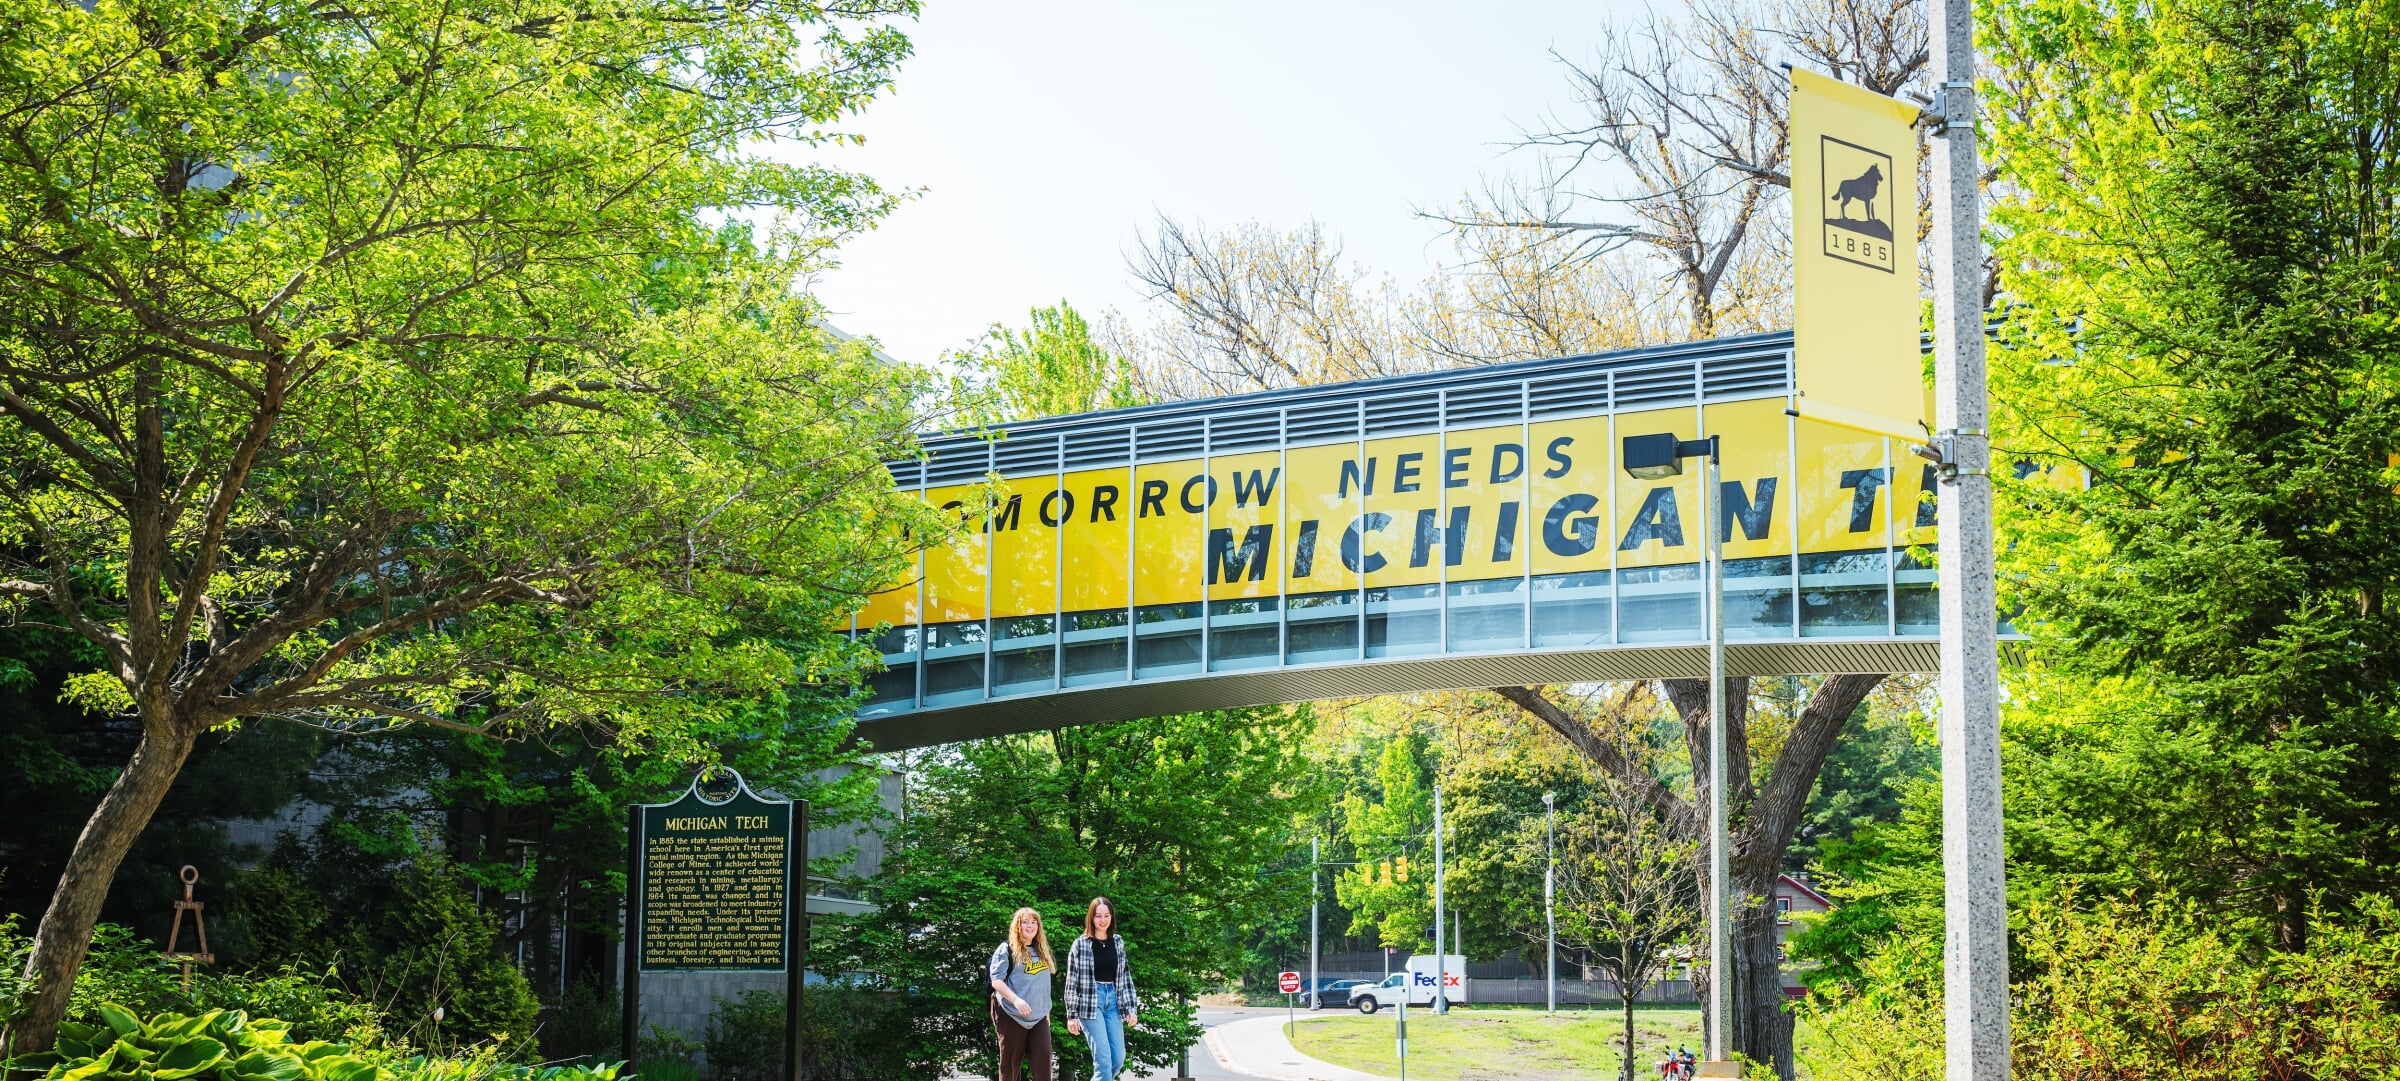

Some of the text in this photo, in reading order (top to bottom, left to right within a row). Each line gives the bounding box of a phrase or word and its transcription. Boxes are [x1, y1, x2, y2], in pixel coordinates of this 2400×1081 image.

[1832, 234, 1886, 261] 1885
[902, 436, 1574, 541] MORROW NEEDS
[1201, 476, 1778, 586] MICHIGAN
[666, 816, 769, 830] MICHIGAN TECH
[759, 836, 783, 844] mining
[764, 844, 783, 852] great
[671, 853, 694, 862] mining
[696, 852, 721, 861] region.
[751, 852, 783, 860] Michigan
[649, 861, 674, 870] College
[666, 885, 696, 893] geology.
[752, 884, 771, 892] again
[722, 892, 750, 901] changed
[748, 900, 782, 908] industry's
[648, 908, 683, 917] expanding
[755, 908, 781, 916] present
[672, 916, 702, 925] Michigan
[707, 916, 751, 925] Technological
[648, 932, 697, 941] undergraduate
[715, 932, 745, 940] graduate
[669, 940, 696, 949] original
[701, 940, 730, 948] subjects
